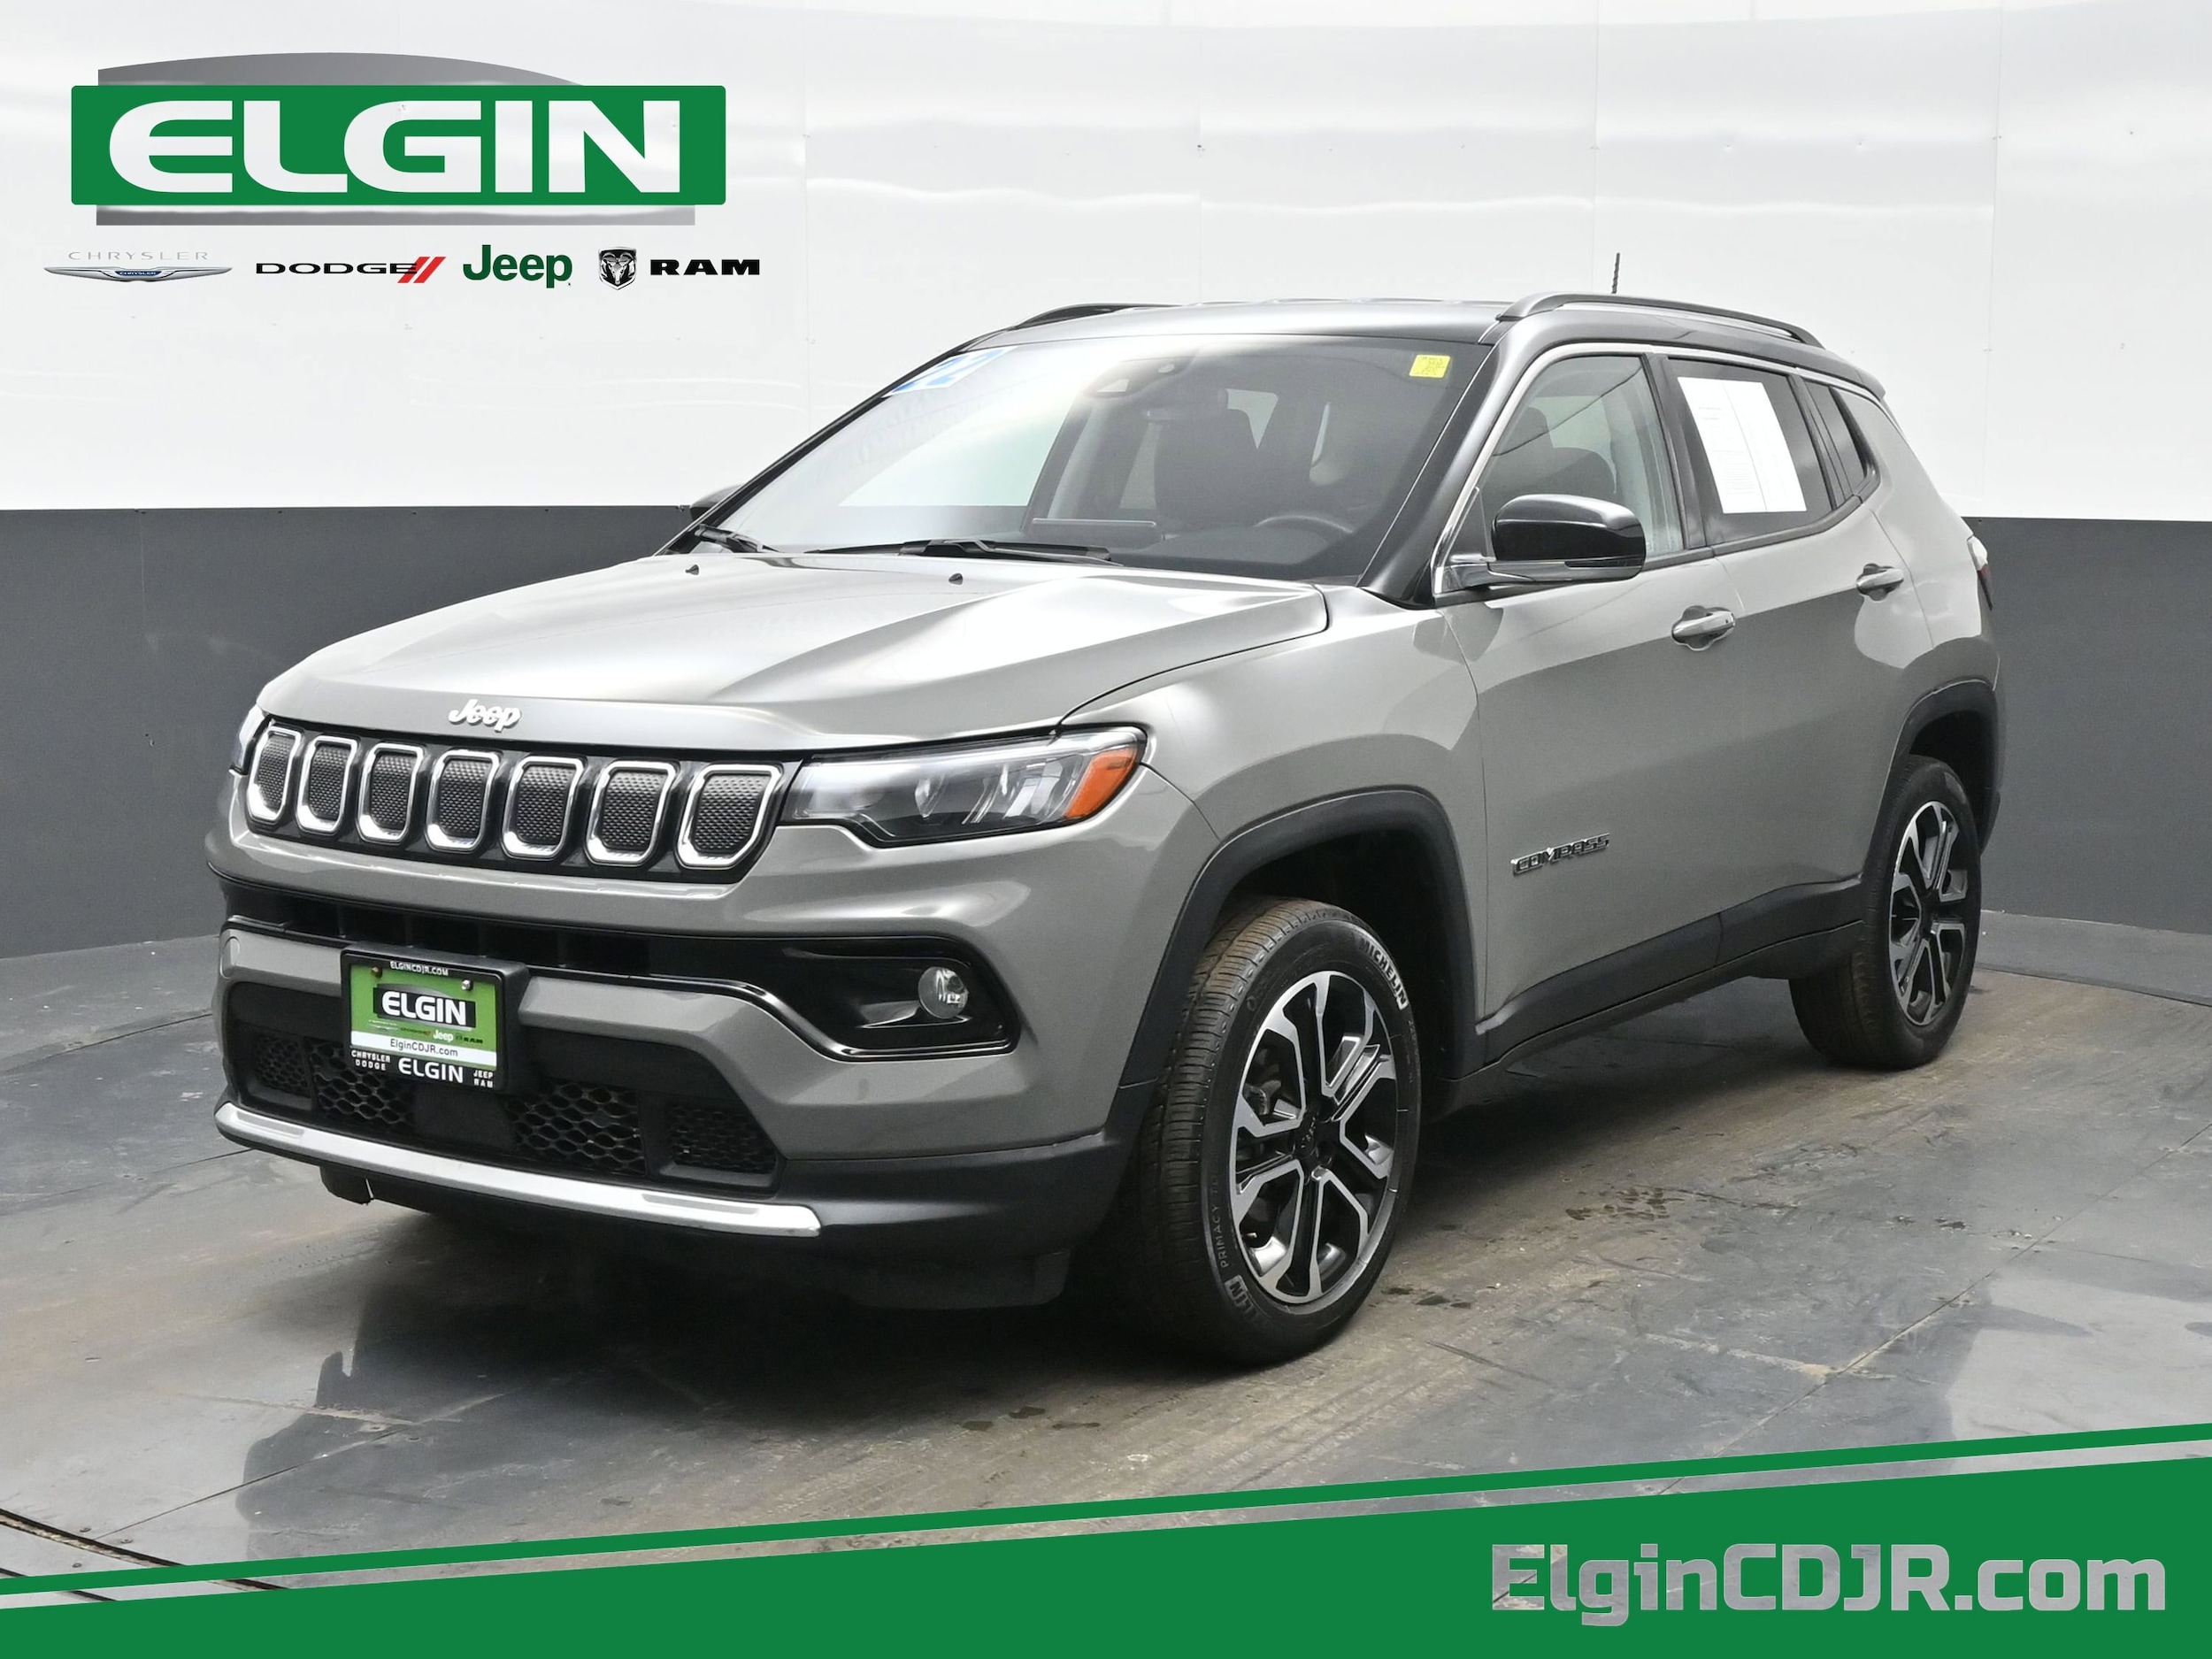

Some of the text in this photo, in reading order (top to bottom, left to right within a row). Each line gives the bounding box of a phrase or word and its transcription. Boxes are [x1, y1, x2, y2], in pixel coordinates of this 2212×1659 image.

[448, 698, 522, 733] Jeep
[1510, 833, 1610, 876] COMPASS
[390, 961, 449, 976] ELGINCDJR.COM
[1359, 936, 1409, 1007] MICHELIN
[381, 990, 467, 1026] ELGIN
[433, 1029, 454, 1043] Jeep
[390, 1038, 458, 1056] ElginCDJR.com
[351, 1049, 391, 1064] CHRYSLER
[355, 1059, 387, 1071] DODGE
[398, 1056, 464, 1084] ELGIN
[473, 1069, 494, 1079] JEEP
[473, 1078, 494, 1089] RAM
[1210, 1204, 1229, 1269] PRIMACY
